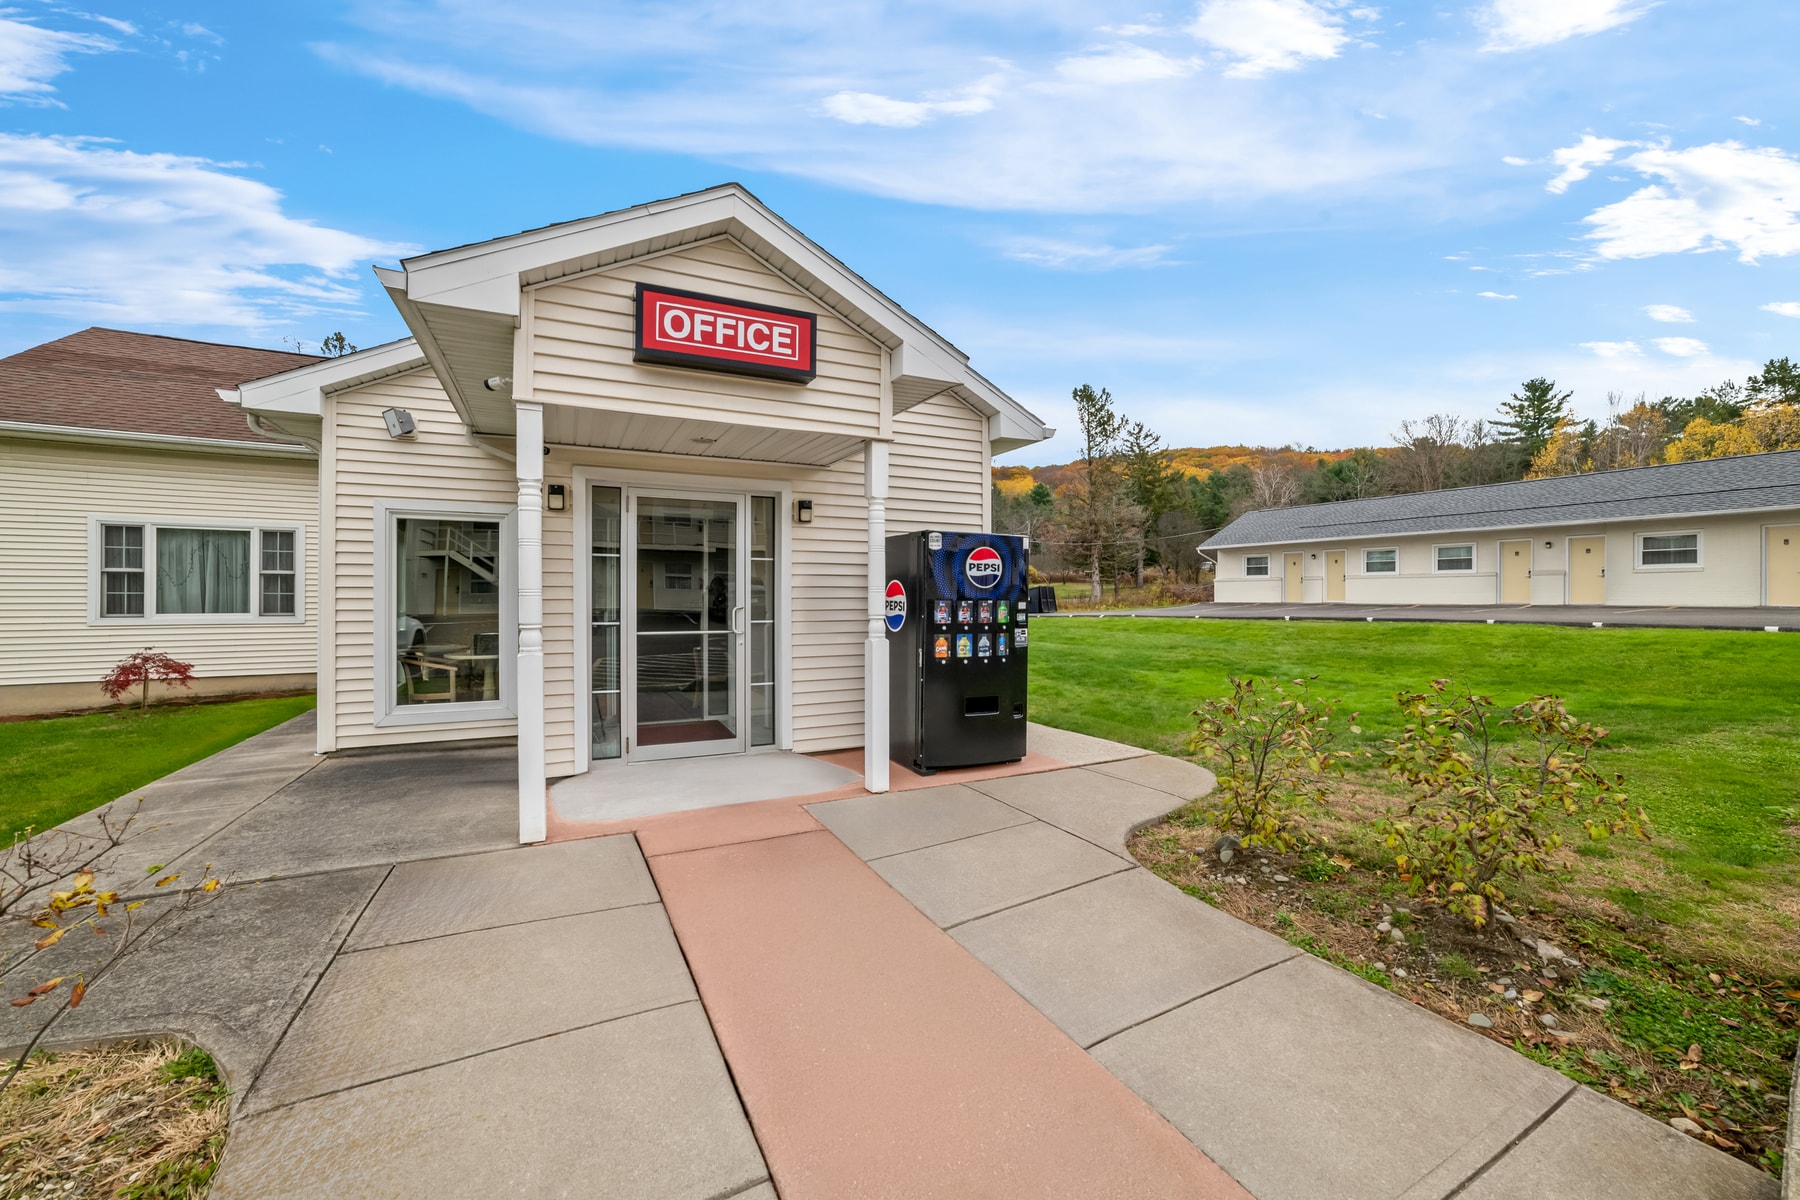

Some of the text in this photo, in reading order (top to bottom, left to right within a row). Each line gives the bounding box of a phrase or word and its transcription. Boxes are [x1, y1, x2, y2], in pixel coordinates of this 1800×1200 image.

[664, 309, 792, 354] OFFICE
[969, 563, 1000, 572] PEPSI
[885, 600, 905, 612] PEPSI
